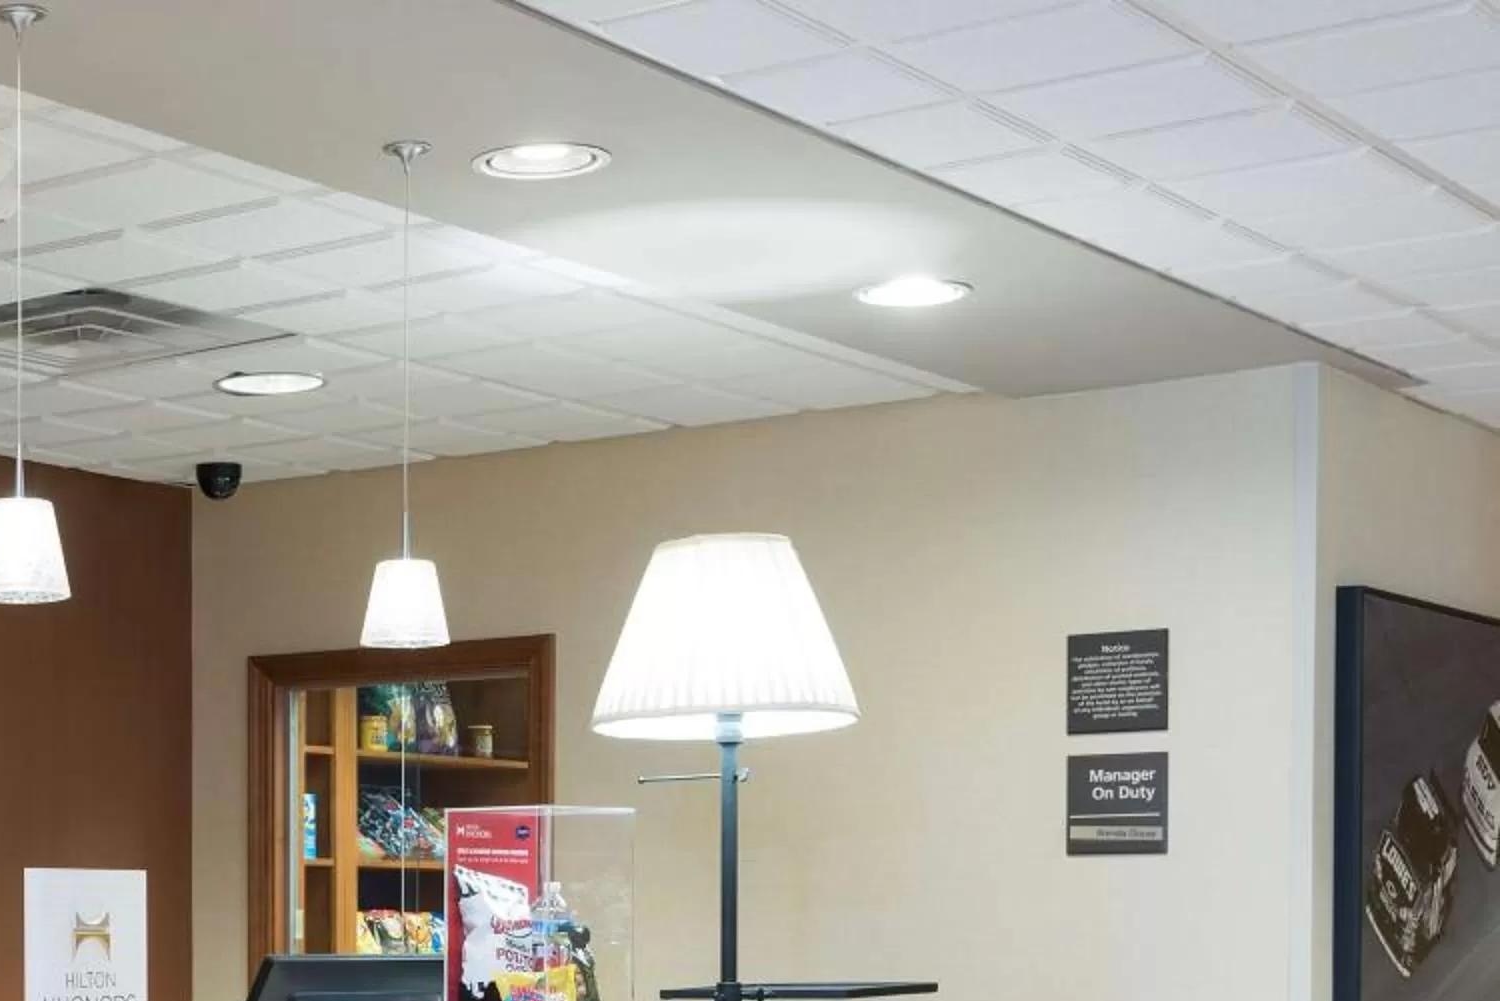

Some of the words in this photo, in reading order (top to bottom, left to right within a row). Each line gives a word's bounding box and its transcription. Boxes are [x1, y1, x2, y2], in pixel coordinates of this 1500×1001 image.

[1088, 769, 1157, 785] Manager
[1091, 787, 1114, 801] On
[1119, 785, 1156, 802] Duty
[65, 971, 117, 989] HILTON
